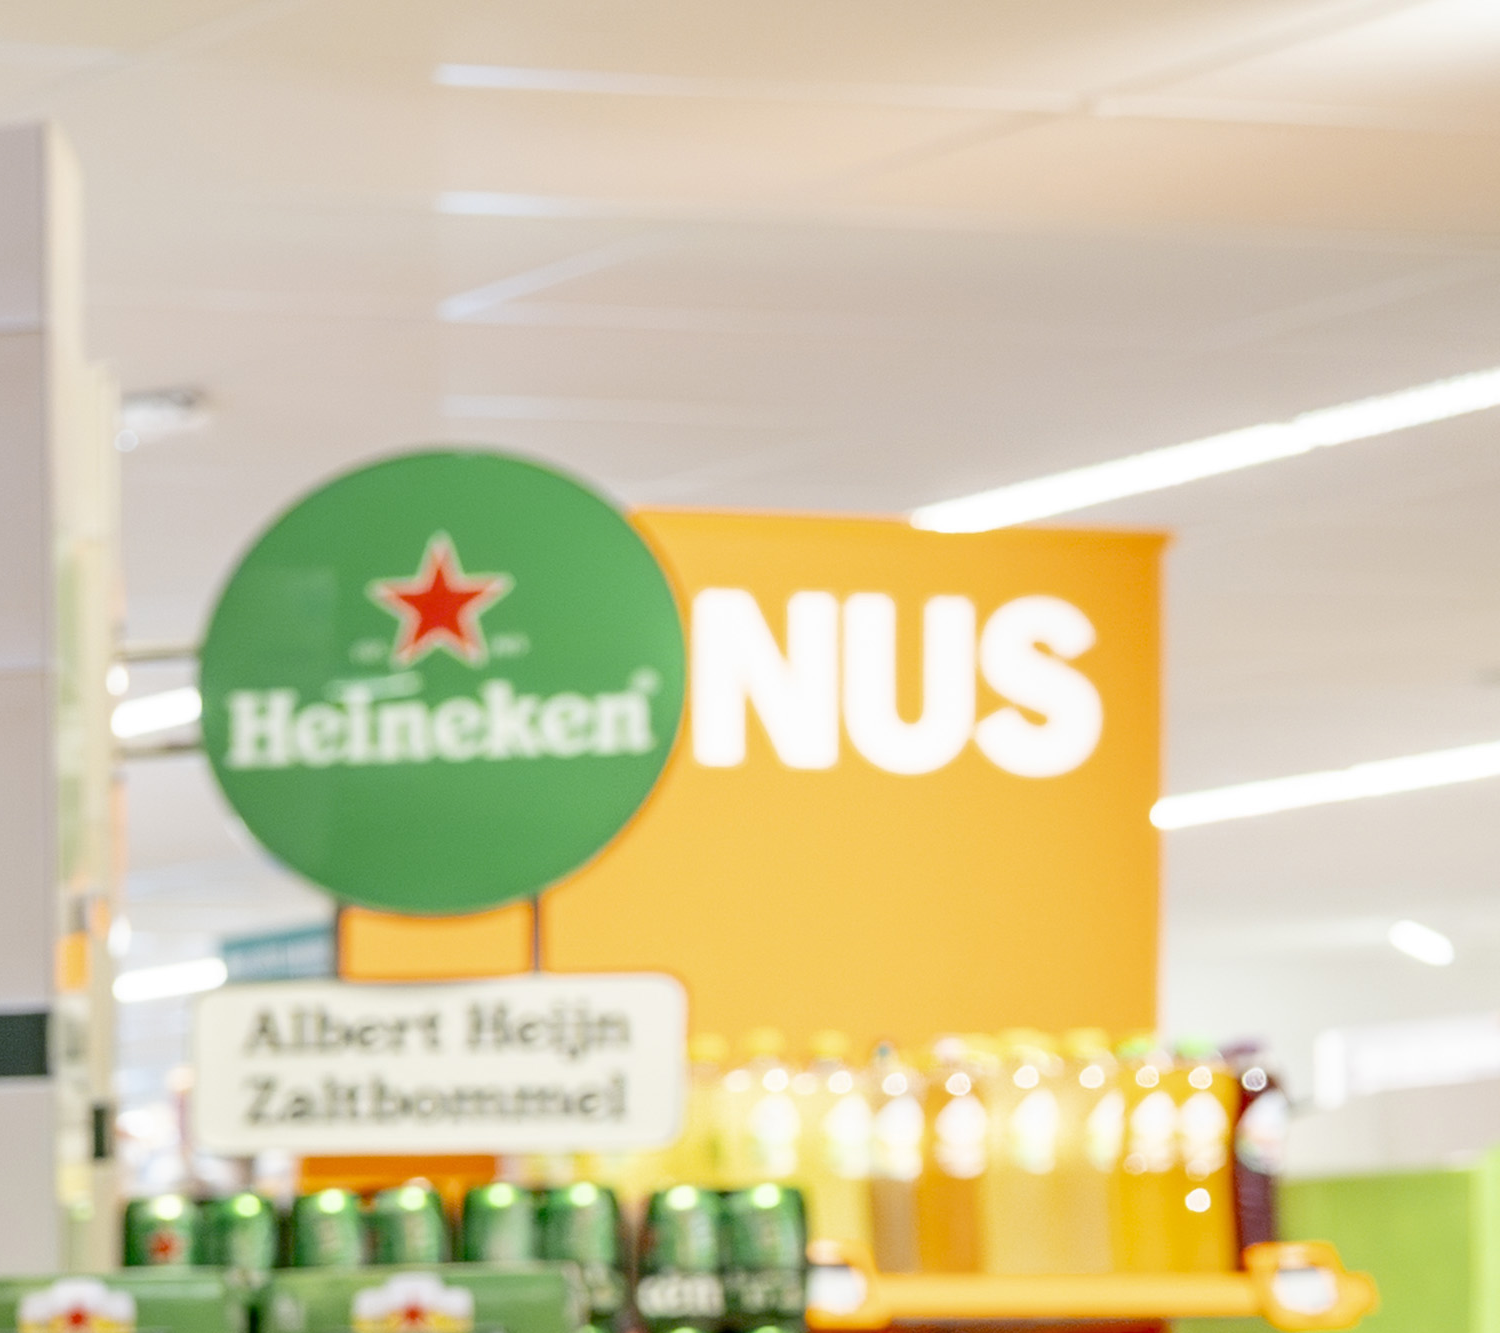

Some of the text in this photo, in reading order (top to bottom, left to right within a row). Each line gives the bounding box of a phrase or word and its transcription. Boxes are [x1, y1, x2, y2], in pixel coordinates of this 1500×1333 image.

[691, 587, 1102, 778] NUS
[229, 679, 656, 768] Heineken
[244, 1000, 632, 1060] Albert Heijn
[245, 1074, 628, 1126] Zaltbommel
